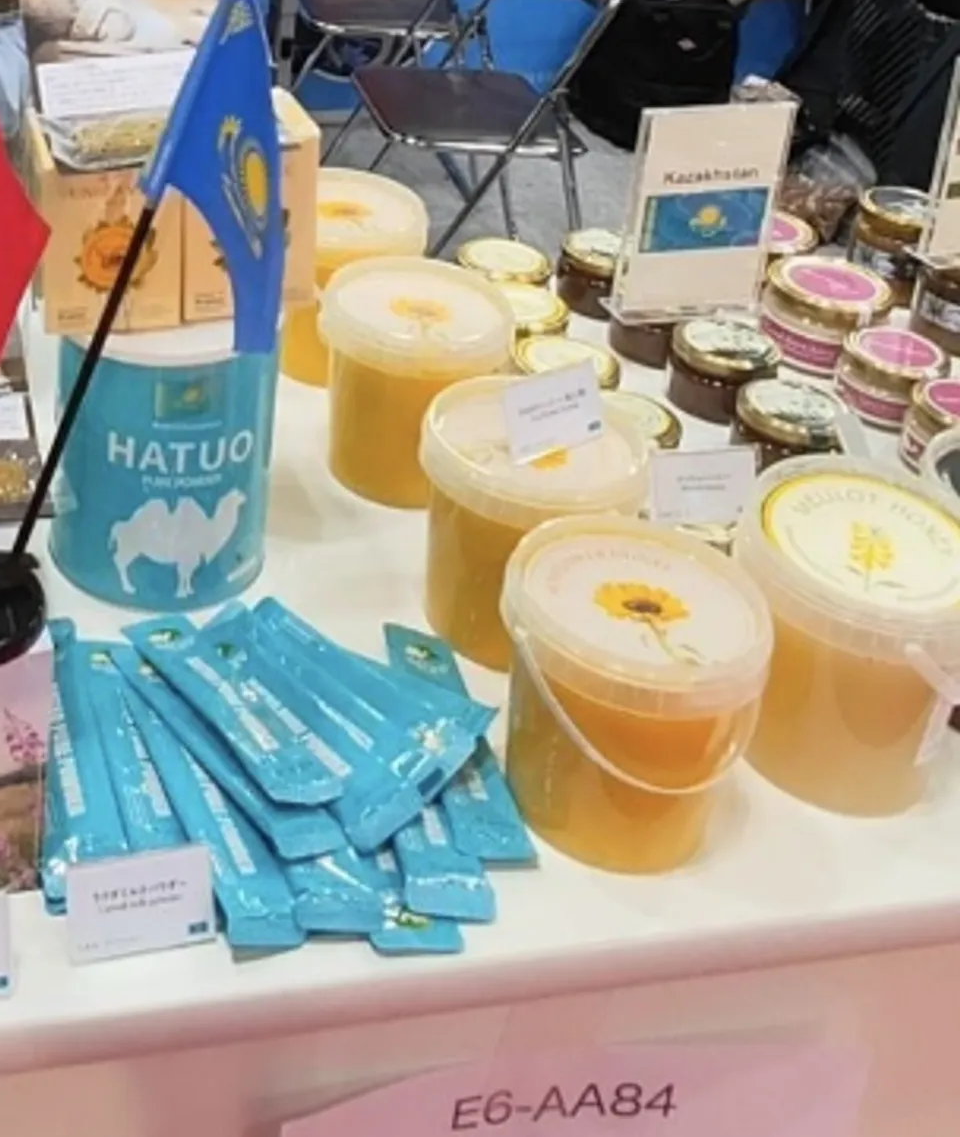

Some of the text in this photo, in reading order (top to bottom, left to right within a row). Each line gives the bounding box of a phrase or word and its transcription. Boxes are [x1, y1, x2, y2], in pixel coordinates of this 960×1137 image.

[663, 168, 759, 185] Kazakhstan
[107, 429, 254, 475] HATUO
[451, 1082, 678, 1131] E6-AA84
